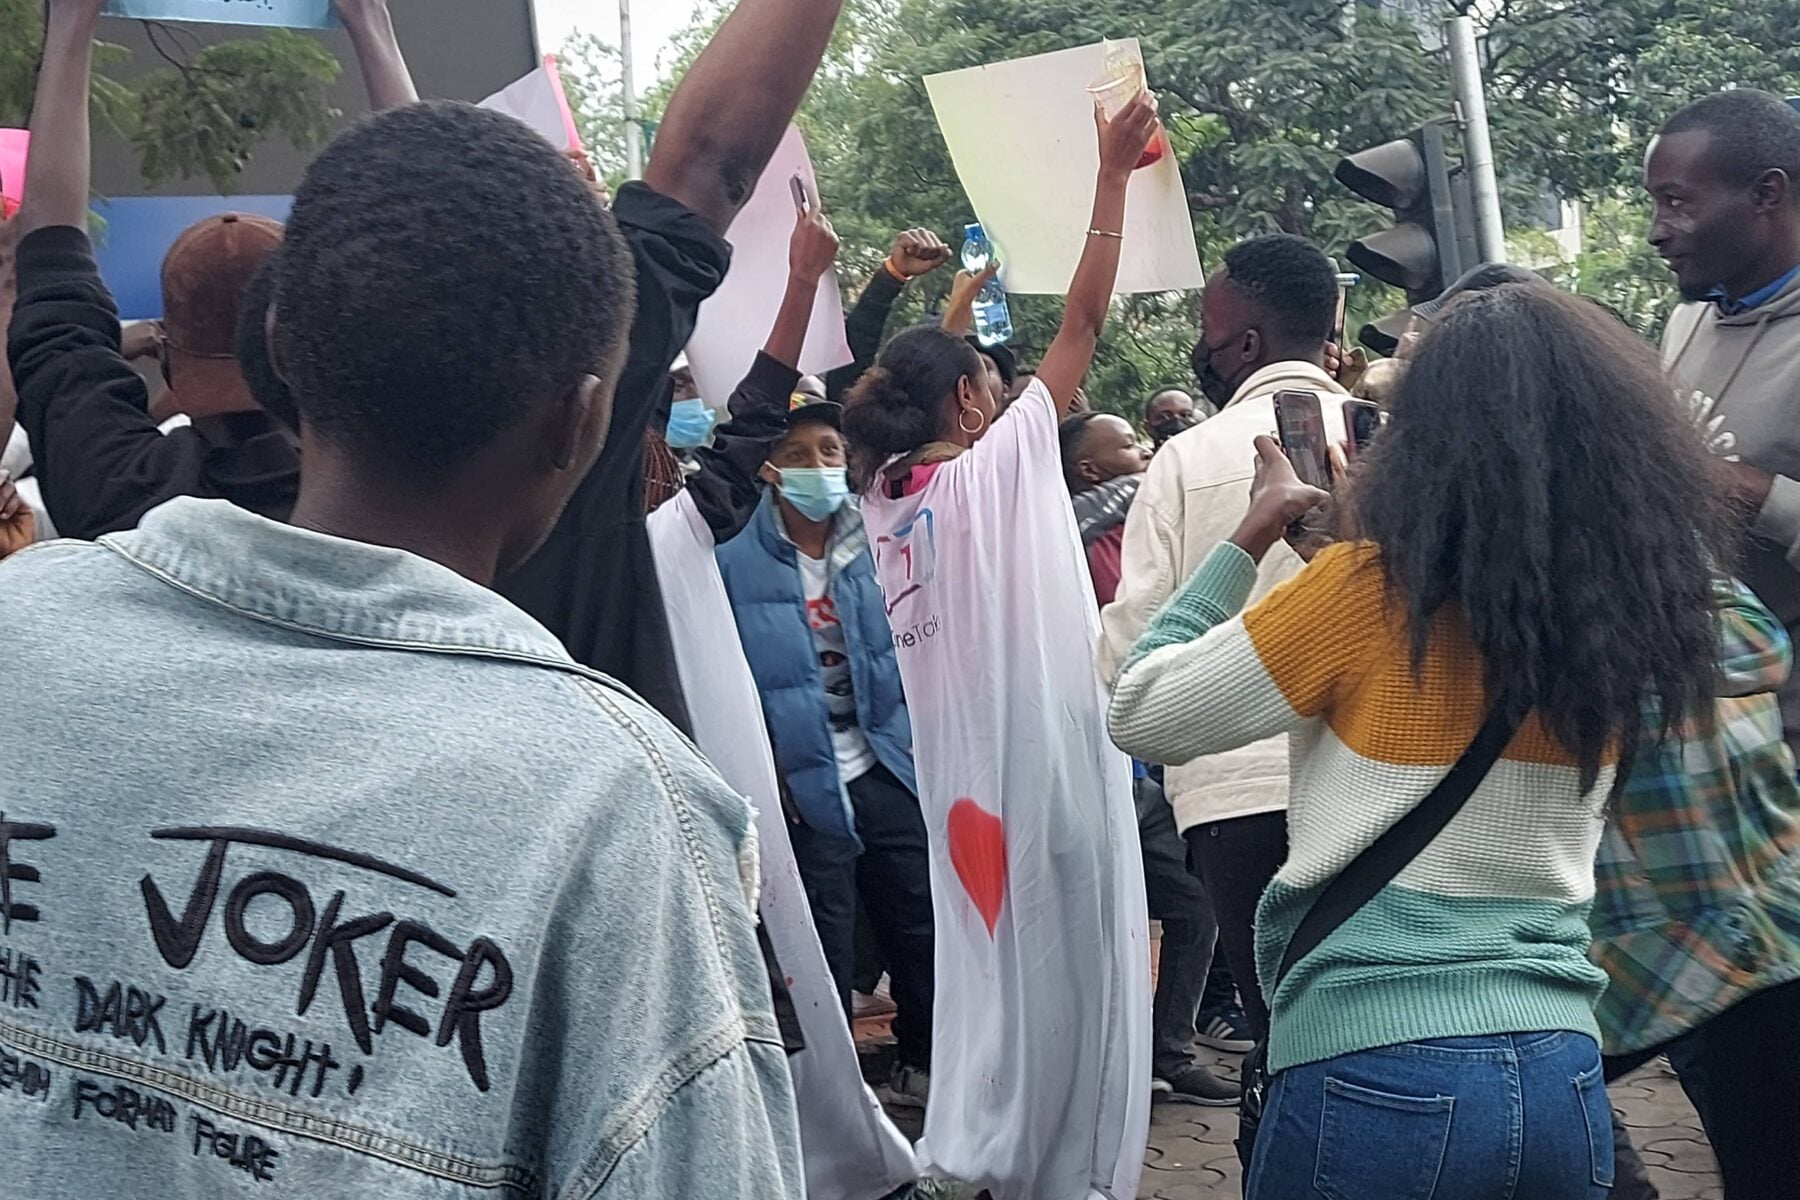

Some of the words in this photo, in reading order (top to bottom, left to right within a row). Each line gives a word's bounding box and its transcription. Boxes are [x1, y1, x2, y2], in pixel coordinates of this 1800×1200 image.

[0, 945, 43, 1009] HE
[73, 975, 168, 1055] DARK
[140, 826, 514, 1093] JOKER
